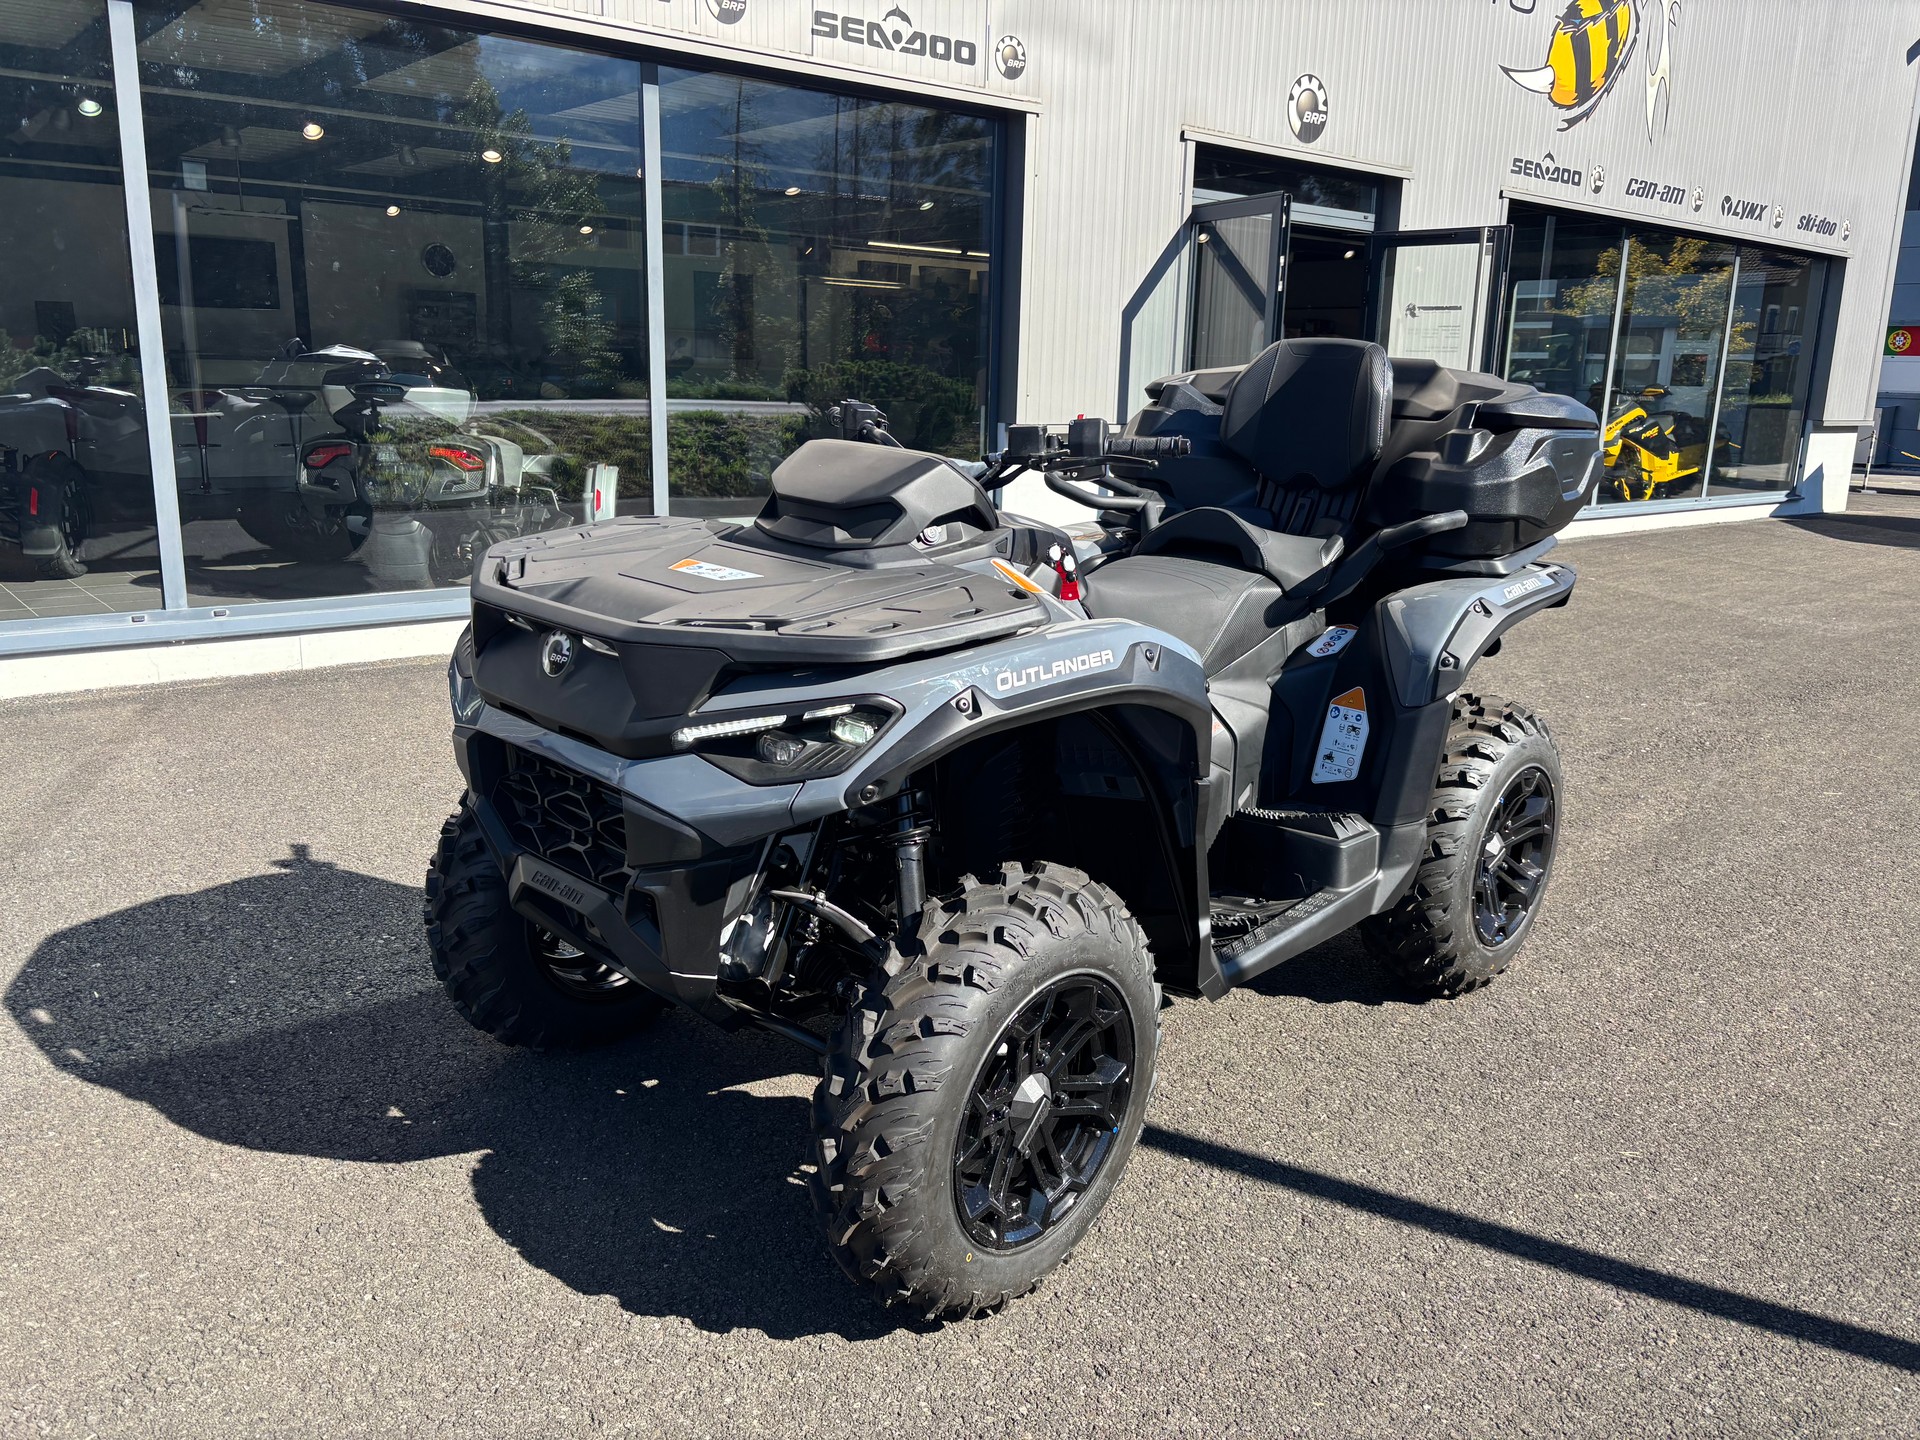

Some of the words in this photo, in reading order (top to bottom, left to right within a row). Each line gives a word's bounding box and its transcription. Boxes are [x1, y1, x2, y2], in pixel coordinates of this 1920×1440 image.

[721, 0, 746, 12] BRP
[1007, 59, 1025, 69] BRP
[1303, 110, 1327, 125] BRP
[1797, 213, 1838, 237] ski-doo
[550, 652, 568, 665] BRP
[995, 649, 1115, 692] OUTLANDER
